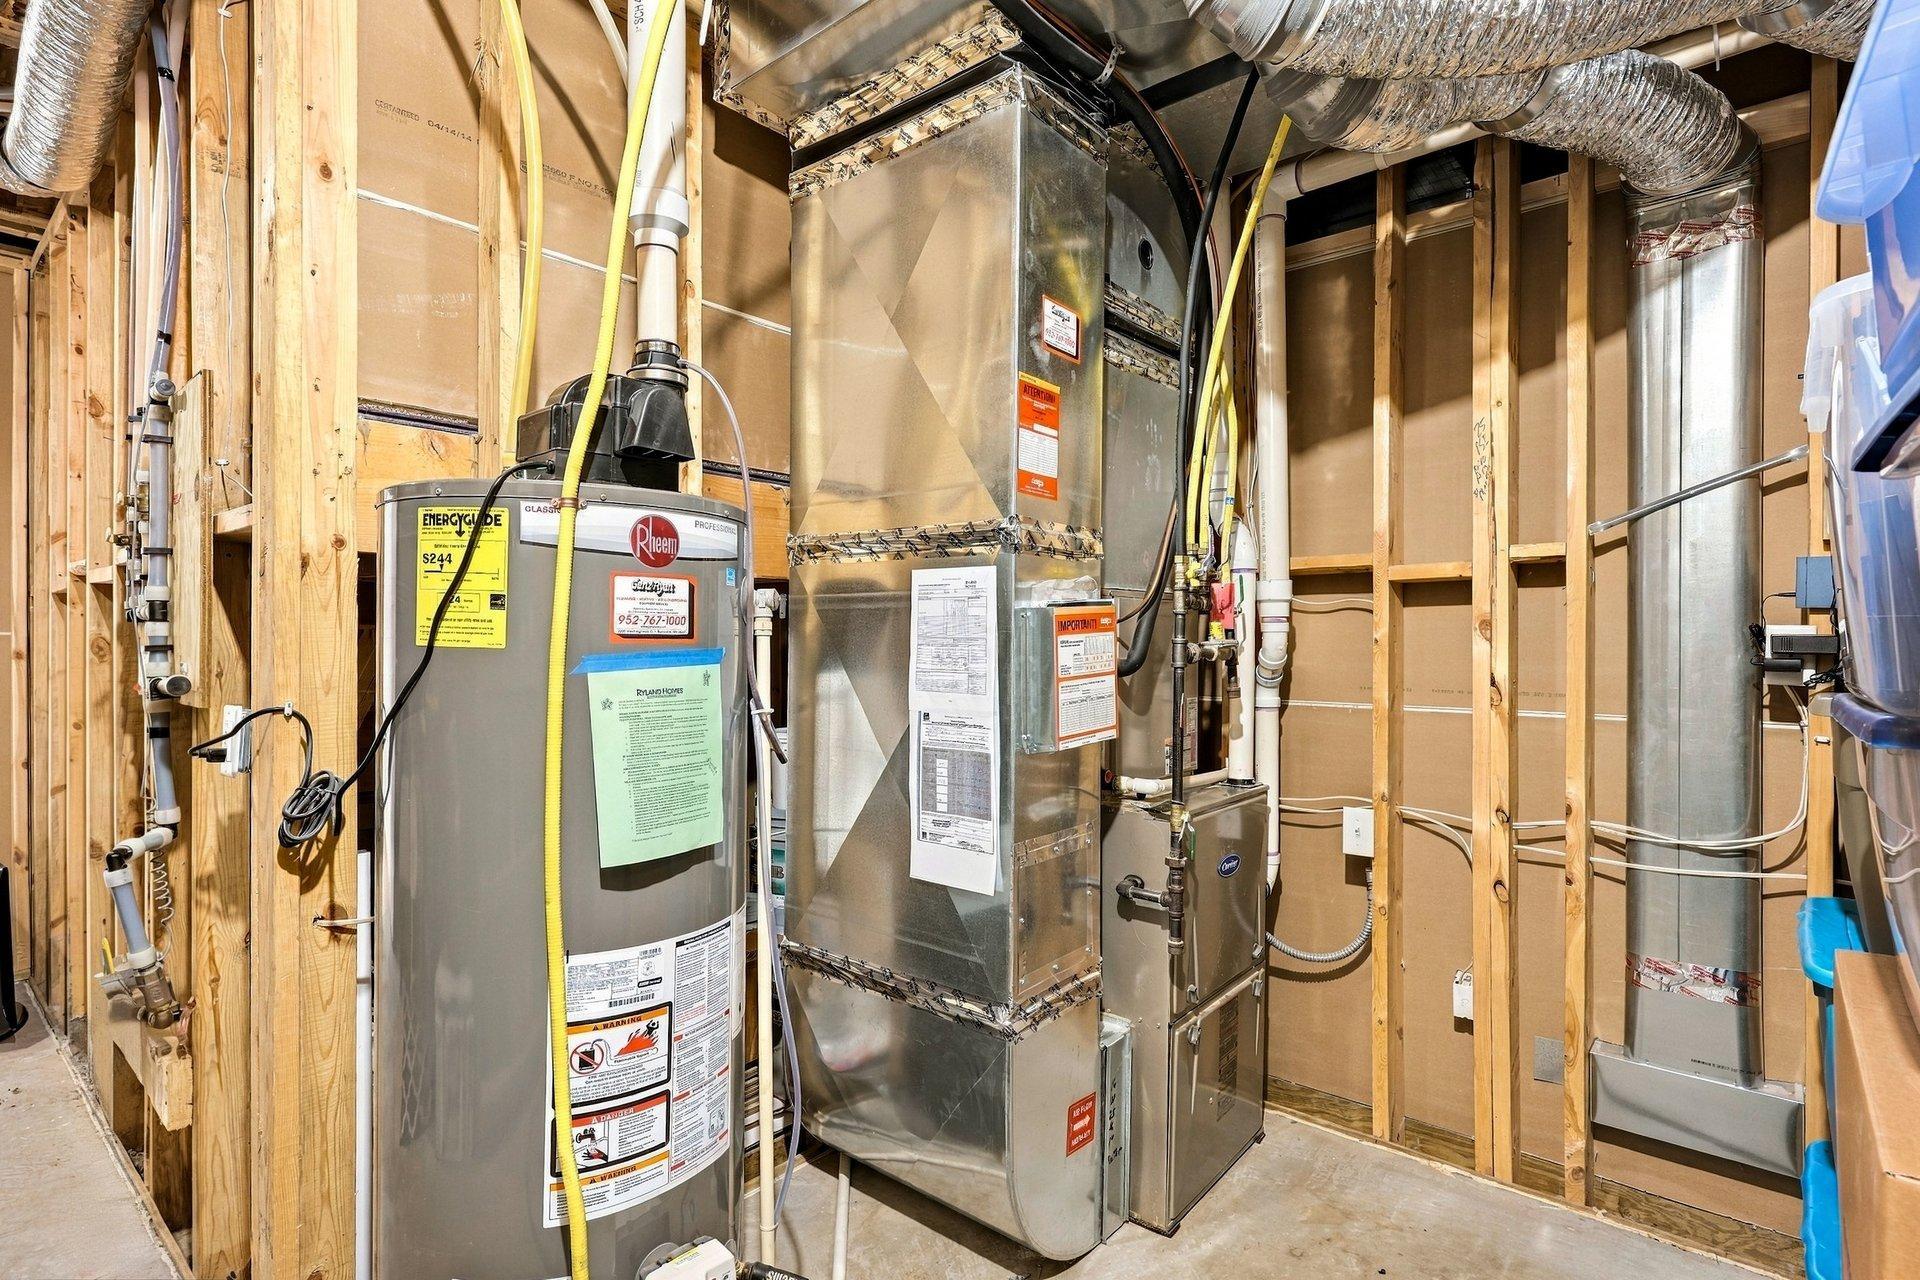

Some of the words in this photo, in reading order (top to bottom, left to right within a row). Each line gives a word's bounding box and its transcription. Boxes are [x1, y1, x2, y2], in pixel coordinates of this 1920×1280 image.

[634, 4, 644, 25] SCH
[637, 516, 677, 560] Rheem
[618, 614, 687, 626] 952-767-1000
[636, 688, 662, 697] RYLAND
[662, 687, 684, 695] HOMES
[1221, 860, 1239, 871] Carrier
[602, 1016, 643, 1030] WARNING
[600, 1108, 635, 1123] DANGER
[600, 1166, 637, 1182] WARNING
